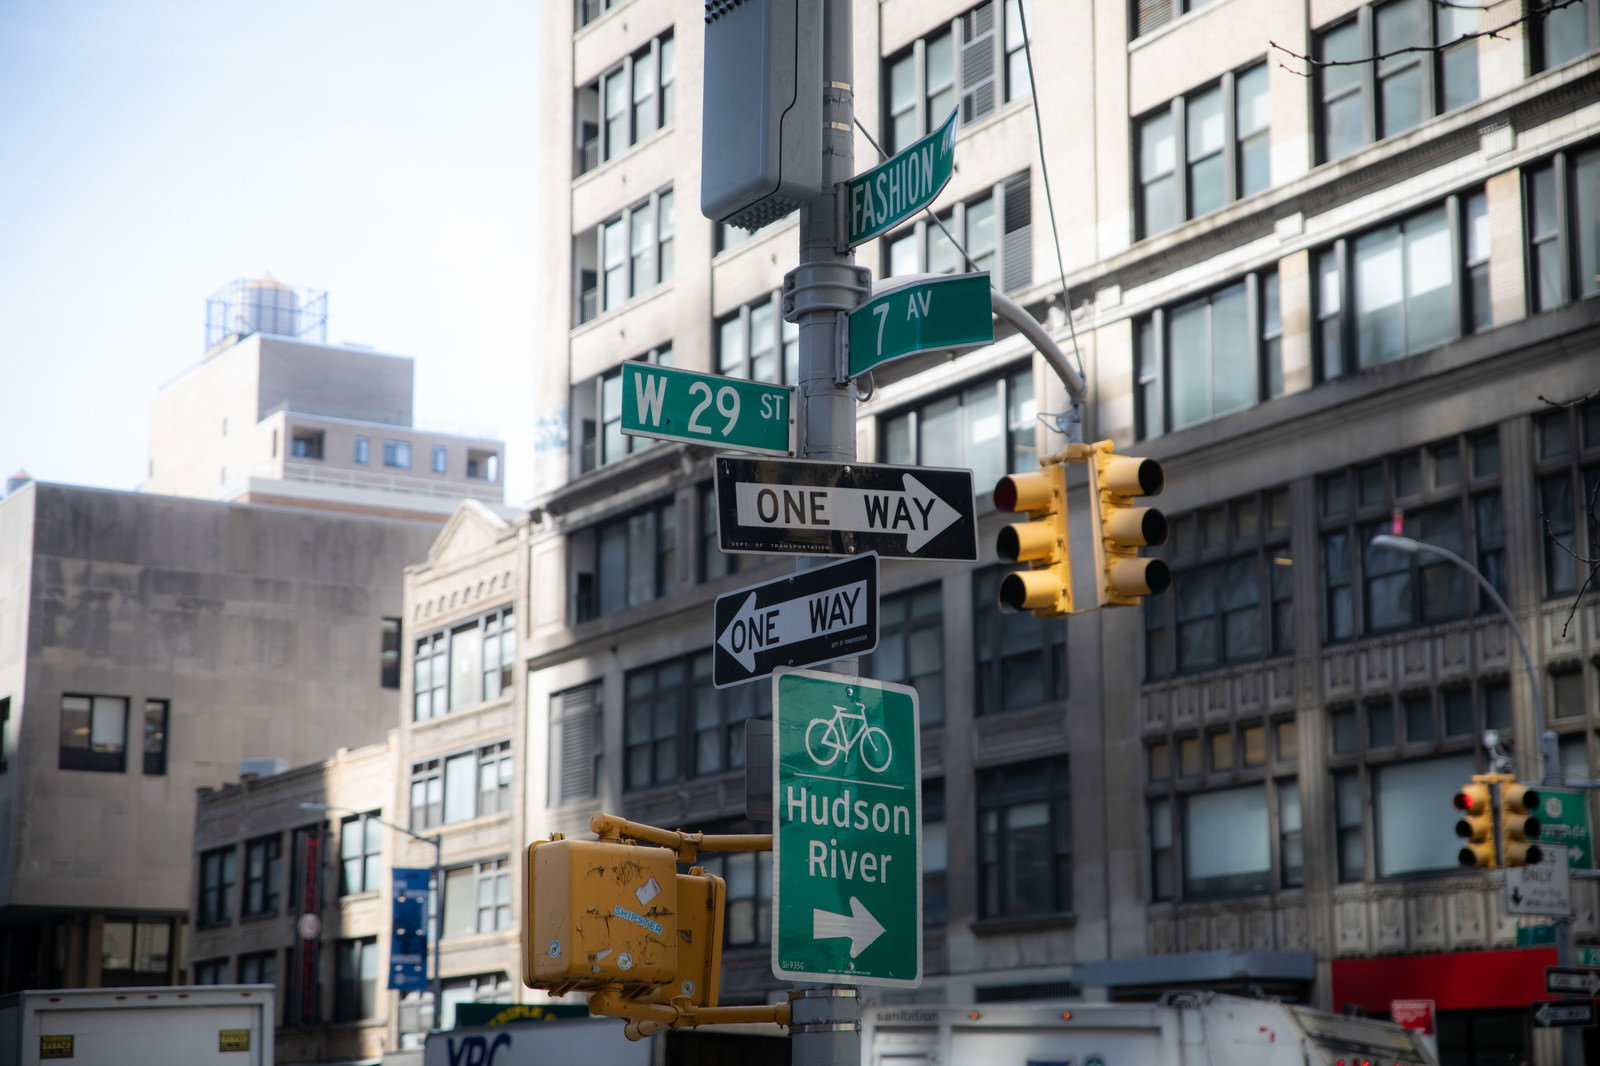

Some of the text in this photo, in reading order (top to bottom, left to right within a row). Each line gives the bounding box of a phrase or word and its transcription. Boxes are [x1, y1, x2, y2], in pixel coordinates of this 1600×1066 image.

[852, 143, 934, 236] FASHION
[873, 290, 932, 356] 7 AV
[634, 372, 784, 437] W 29 ST
[757, 488, 936, 531] ONE WAY
[731, 587, 861, 654] ONE WAY
[787, 785, 910, 836] Hudson
[808, 838, 892, 883] River
[614, 905, 663, 936] SHIPSTER
